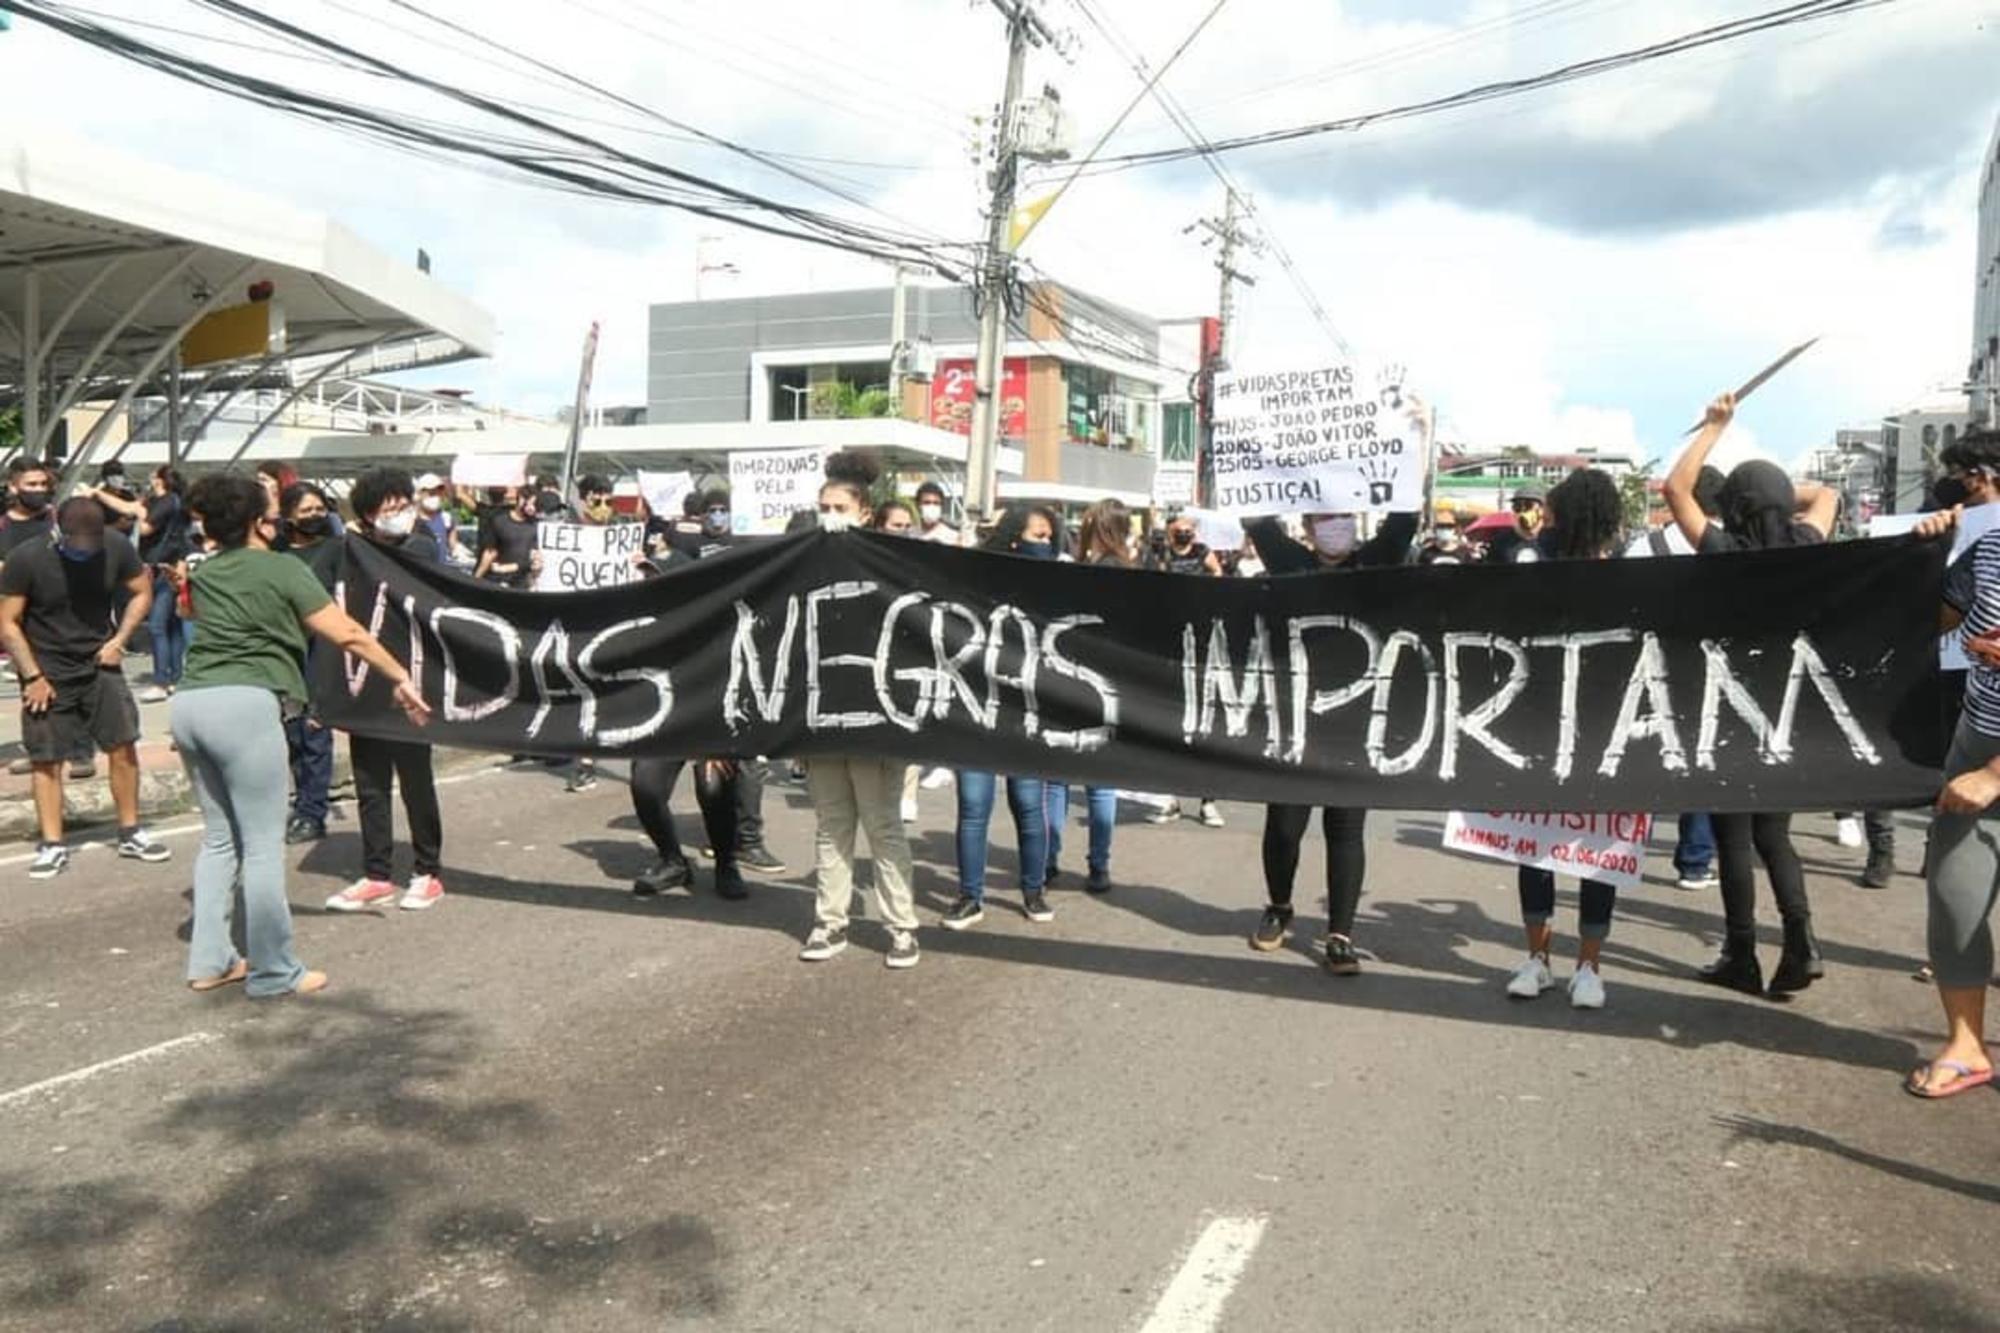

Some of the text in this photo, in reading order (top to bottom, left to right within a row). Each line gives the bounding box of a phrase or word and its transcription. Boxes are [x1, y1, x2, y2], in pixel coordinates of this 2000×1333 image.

[1218, 366, 1354, 399] #VIDASPRETAS
[1261, 385, 1354, 411] IMPORTAM
[1321, 401, 1378, 423] PEDRO
[1272, 427, 1318, 450] JOÃO
[1322, 420, 1378, 442] VITOR
[733, 453, 819, 475] AMAZONAS
[1275, 446, 1342, 468] GEORGE
[1347, 438, 1403, 460] FLOYD
[755, 478, 796, 495] PELA
[1220, 479, 1322, 506] JUSTIÇA!
[542, 525, 642, 555] LEI PRA
[559, 556, 629, 590] QUEM
[335, 580, 1882, 781] VIDAS NEGRAS IMPORTAM
